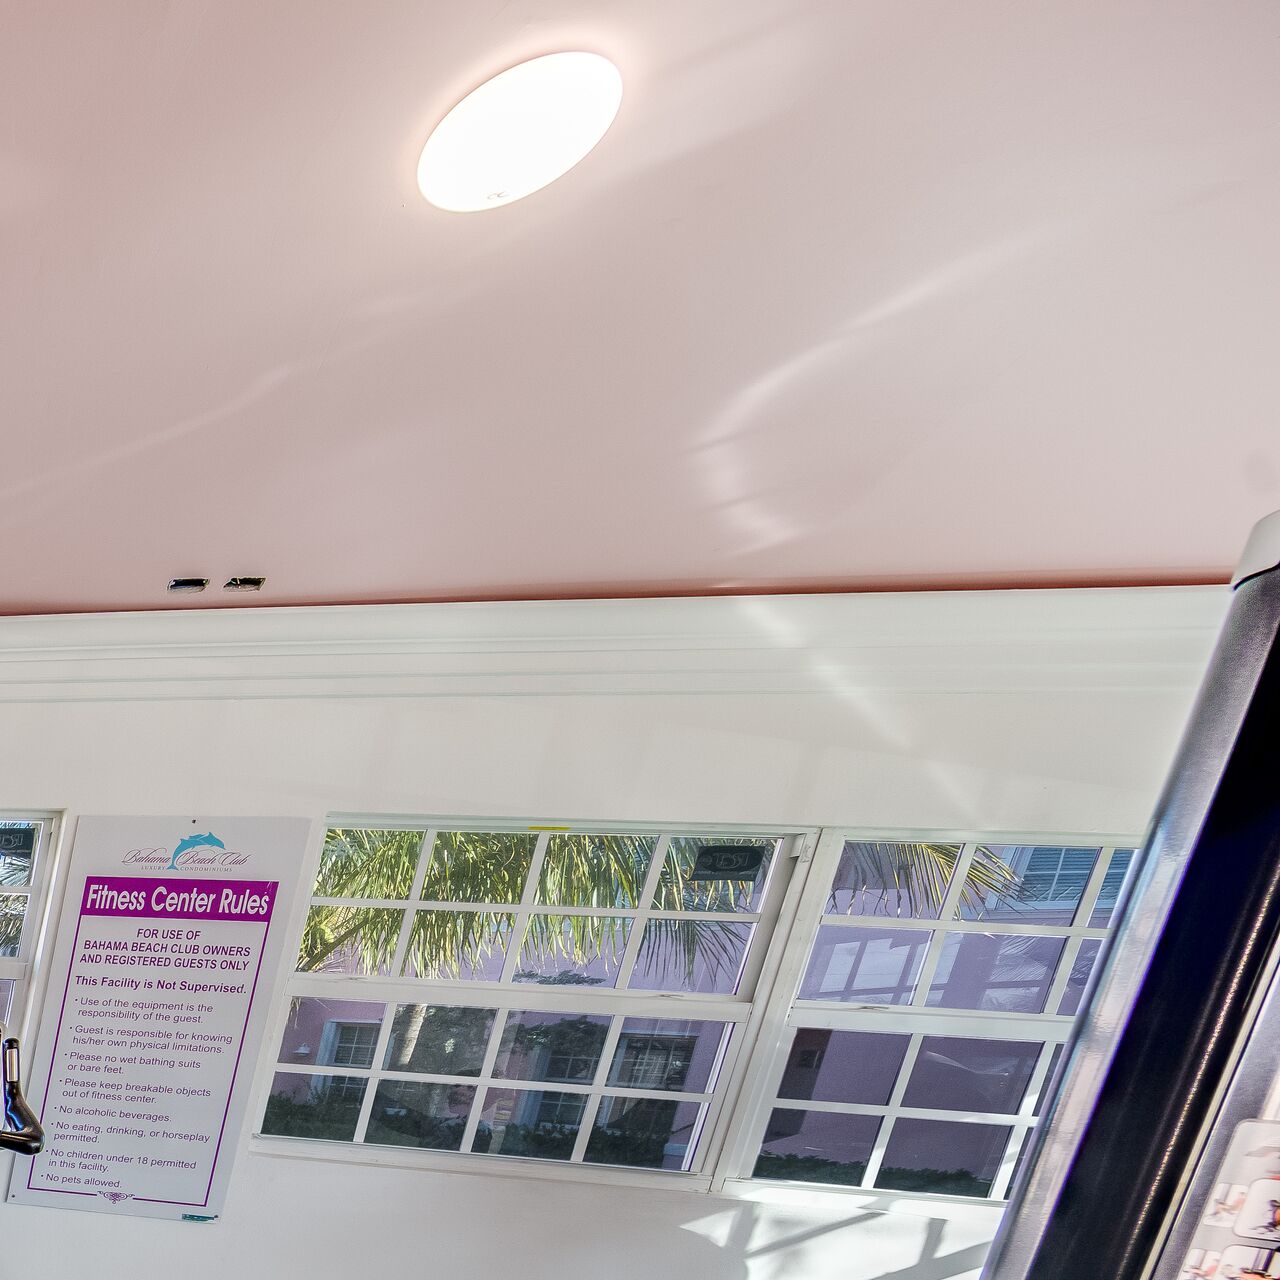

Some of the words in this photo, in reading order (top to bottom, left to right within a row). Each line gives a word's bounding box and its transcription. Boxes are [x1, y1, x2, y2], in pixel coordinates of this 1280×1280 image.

[121, 847, 171, 865] Bahama
[175, 849, 218, 865] Beach
[218, 852, 255, 866] Club
[86, 884, 147, 910] Fitness
[151, 886, 216, 913] Center
[219, 888, 269, 915] Rules
[137, 928, 159, 939] FOR
[161, 930, 183, 940] USE
[186, 930, 201, 940] OF
[84, 940, 128, 951] BAHAMA
[131, 942, 167, 953] BEACH
[170, 944, 200, 954] CLUB
[202, 945, 251, 957] OWNERS
[79, 954, 102, 964] AND
[104, 955, 171, 967] REGISTERED
[174, 958, 217, 969] GUESTS
[220, 960, 250, 971] ONLY
[75, 975, 98, 986] This
[101, 977, 140, 990] Facility
[144, 979, 153, 989] is
[156, 979, 176, 990] Not
[179, 981, 247, 994] Supervised.
[80, 997, 99, 1006] Use
[102, 998, 112, 1007] of
[114, 999, 129, 1008] the
[132, 1001, 184, 1011] equipment
[186, 1003, 194, 1011] is
[197, 1004, 214, 1013] the
[78, 1008, 141, 1021] responsibility
[143, 1012, 153, 1020] of
[155, 1013, 171, 1021] the
[173, 1014, 203, 1024] guest.
[74, 1024, 103, 1035] Guest
[106, 1027, 114, 1035] is
[116, 1028, 172, 1039] responsible
[175, 1031, 189, 1040] for
[191, 1032, 233, 1044] knowing
[72, 1036, 105, 1046] his/her
[107, 1039, 127, 1047] own
[129, 1040, 169, 1050] physical
[172, 1042, 225, 1054] limitations.
[69, 1052, 102, 1062] Please
[104, 1055, 117, 1063] no
[119, 1056, 137, 1064] wet
[139, 1057, 175, 1068] bathing
[178, 1060, 201, 1069] suits
[79, 1064, 101, 1073] bare
[103, 1065, 124, 1074] feet.
[64, 1078, 97, 1088] Please
[99, 1080, 123, 1091] keep
[125, 1082, 173, 1094] breakable
[175, 1086, 211, 1098] objects
[79, 1090, 90, 1098] of
[91, 1091, 122, 1101] fitness
[125, 1095, 157, 1104] center.
[59, 1105, 73, 1114] No
[75, 1107, 117, 1118] alcoholic
[119, 1111, 172, 1123] beverages.
[53, 1133, 100, 1144] permitted.
[56, 1122, 70, 1130] No
[72, 1123, 104, 1134] eating,
[106, 1126, 146, 1138] drinking,
[162, 1130, 210, 1143] horseplay
[50, 1149, 65, 1157] No
[67, 1150, 104, 1160] children
[106, 1154, 133, 1163] under
[137, 1157, 148, 1165] 18
[150, 1158, 197, 1170] permitted
[59, 1159, 76, 1168] this
[78, 1161, 109, 1173] facility.
[45, 1173, 60, 1182] No
[61, 1176, 82, 1185] pets
[84, 1178, 122, 1188] allowed.
